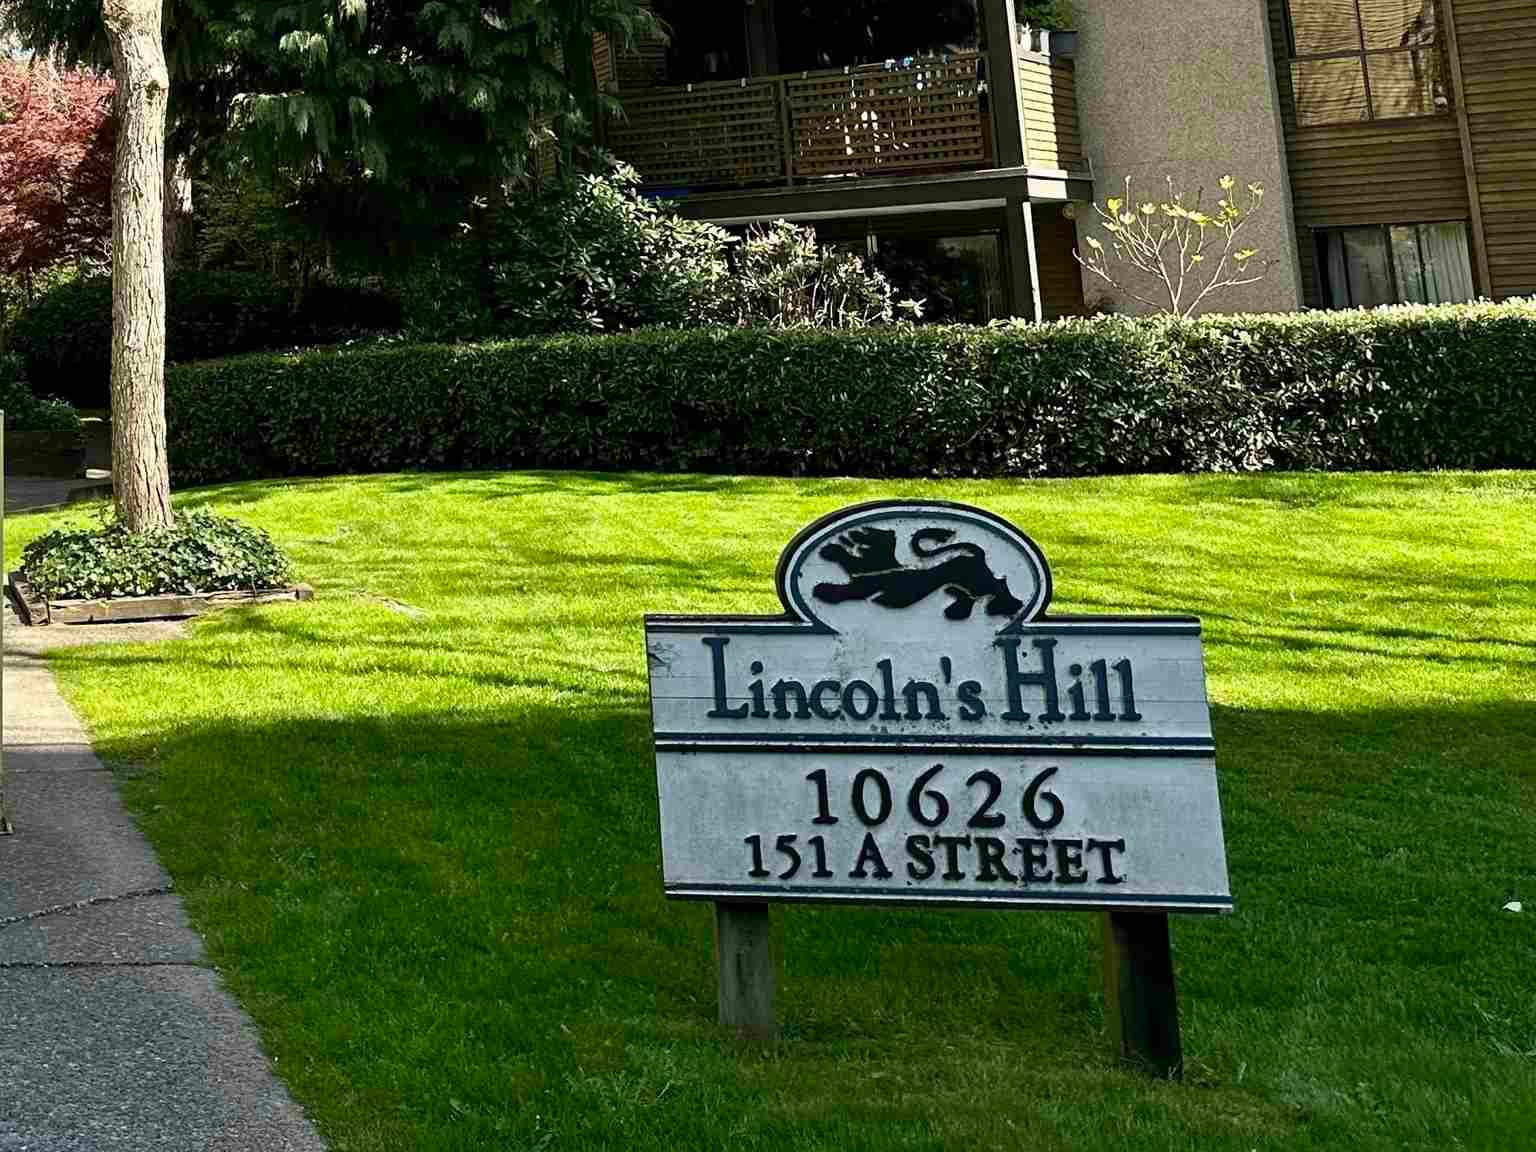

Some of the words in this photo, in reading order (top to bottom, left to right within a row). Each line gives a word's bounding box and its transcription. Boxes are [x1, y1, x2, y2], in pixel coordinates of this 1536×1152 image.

[702, 636, 987, 721] Lincoln's
[994, 637, 1142, 722] Hill
[806, 764, 1065, 829] 10626
[907, 835, 1126, 884] STREET
